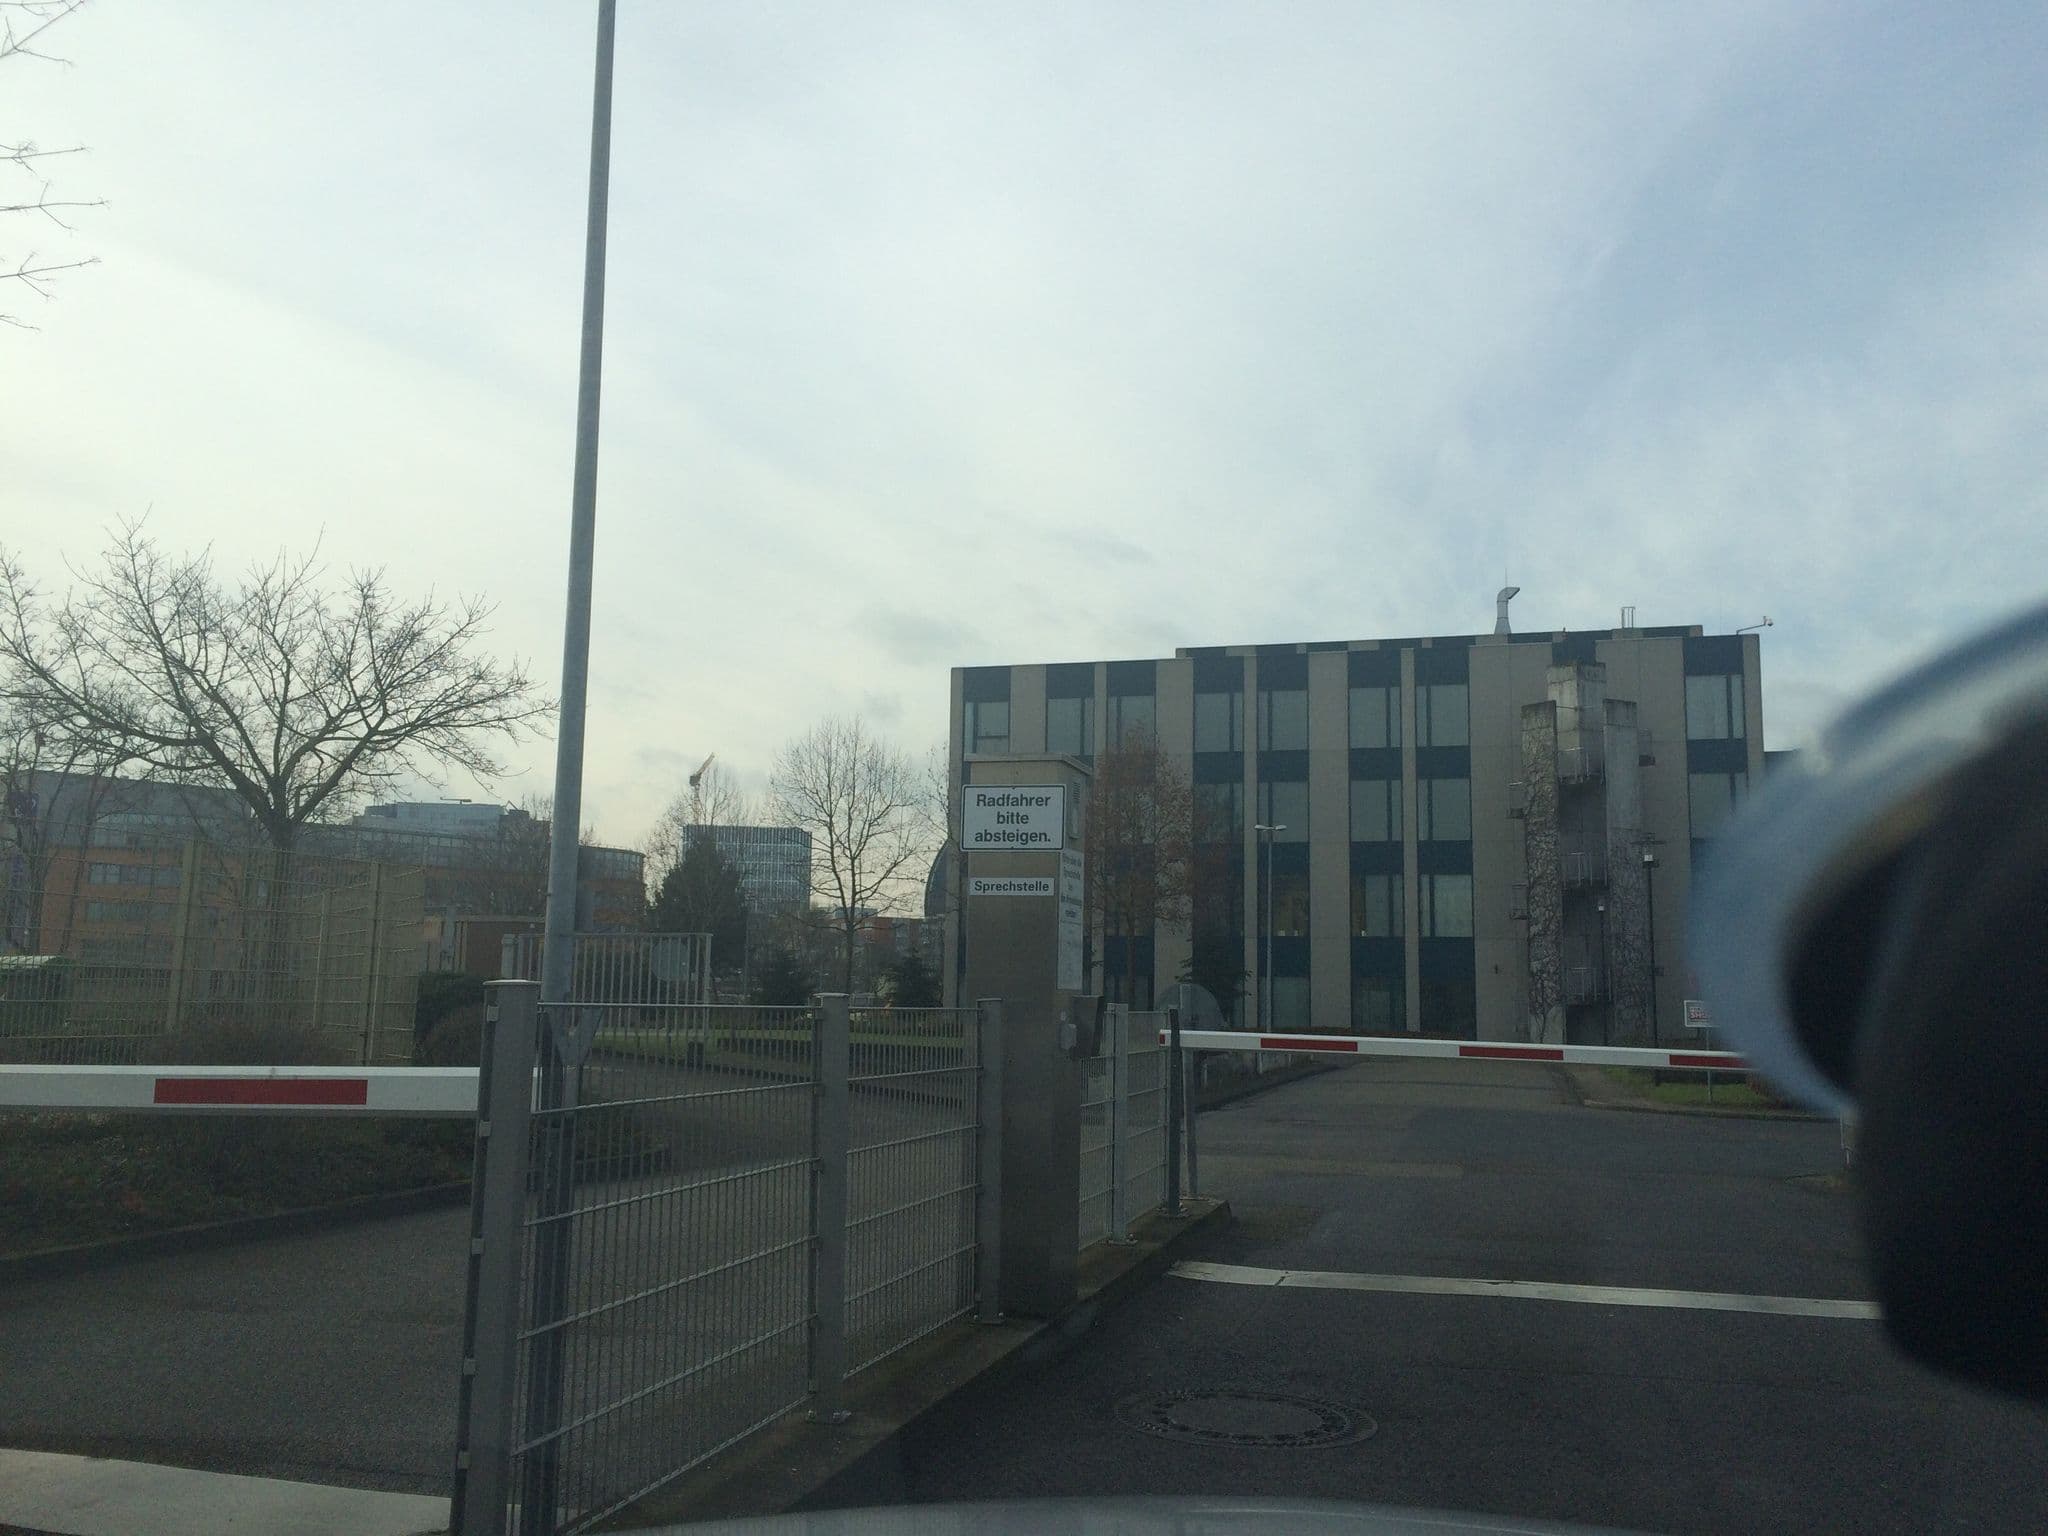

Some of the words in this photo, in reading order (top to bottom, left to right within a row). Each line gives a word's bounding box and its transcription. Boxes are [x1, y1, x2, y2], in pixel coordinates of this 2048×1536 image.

[976, 793, 1051, 807] Radfahrer
[996, 811, 1029, 824] bitte
[975, 829, 1051, 845] absteigen.
[974, 880, 1050, 894] Sprechstelle
